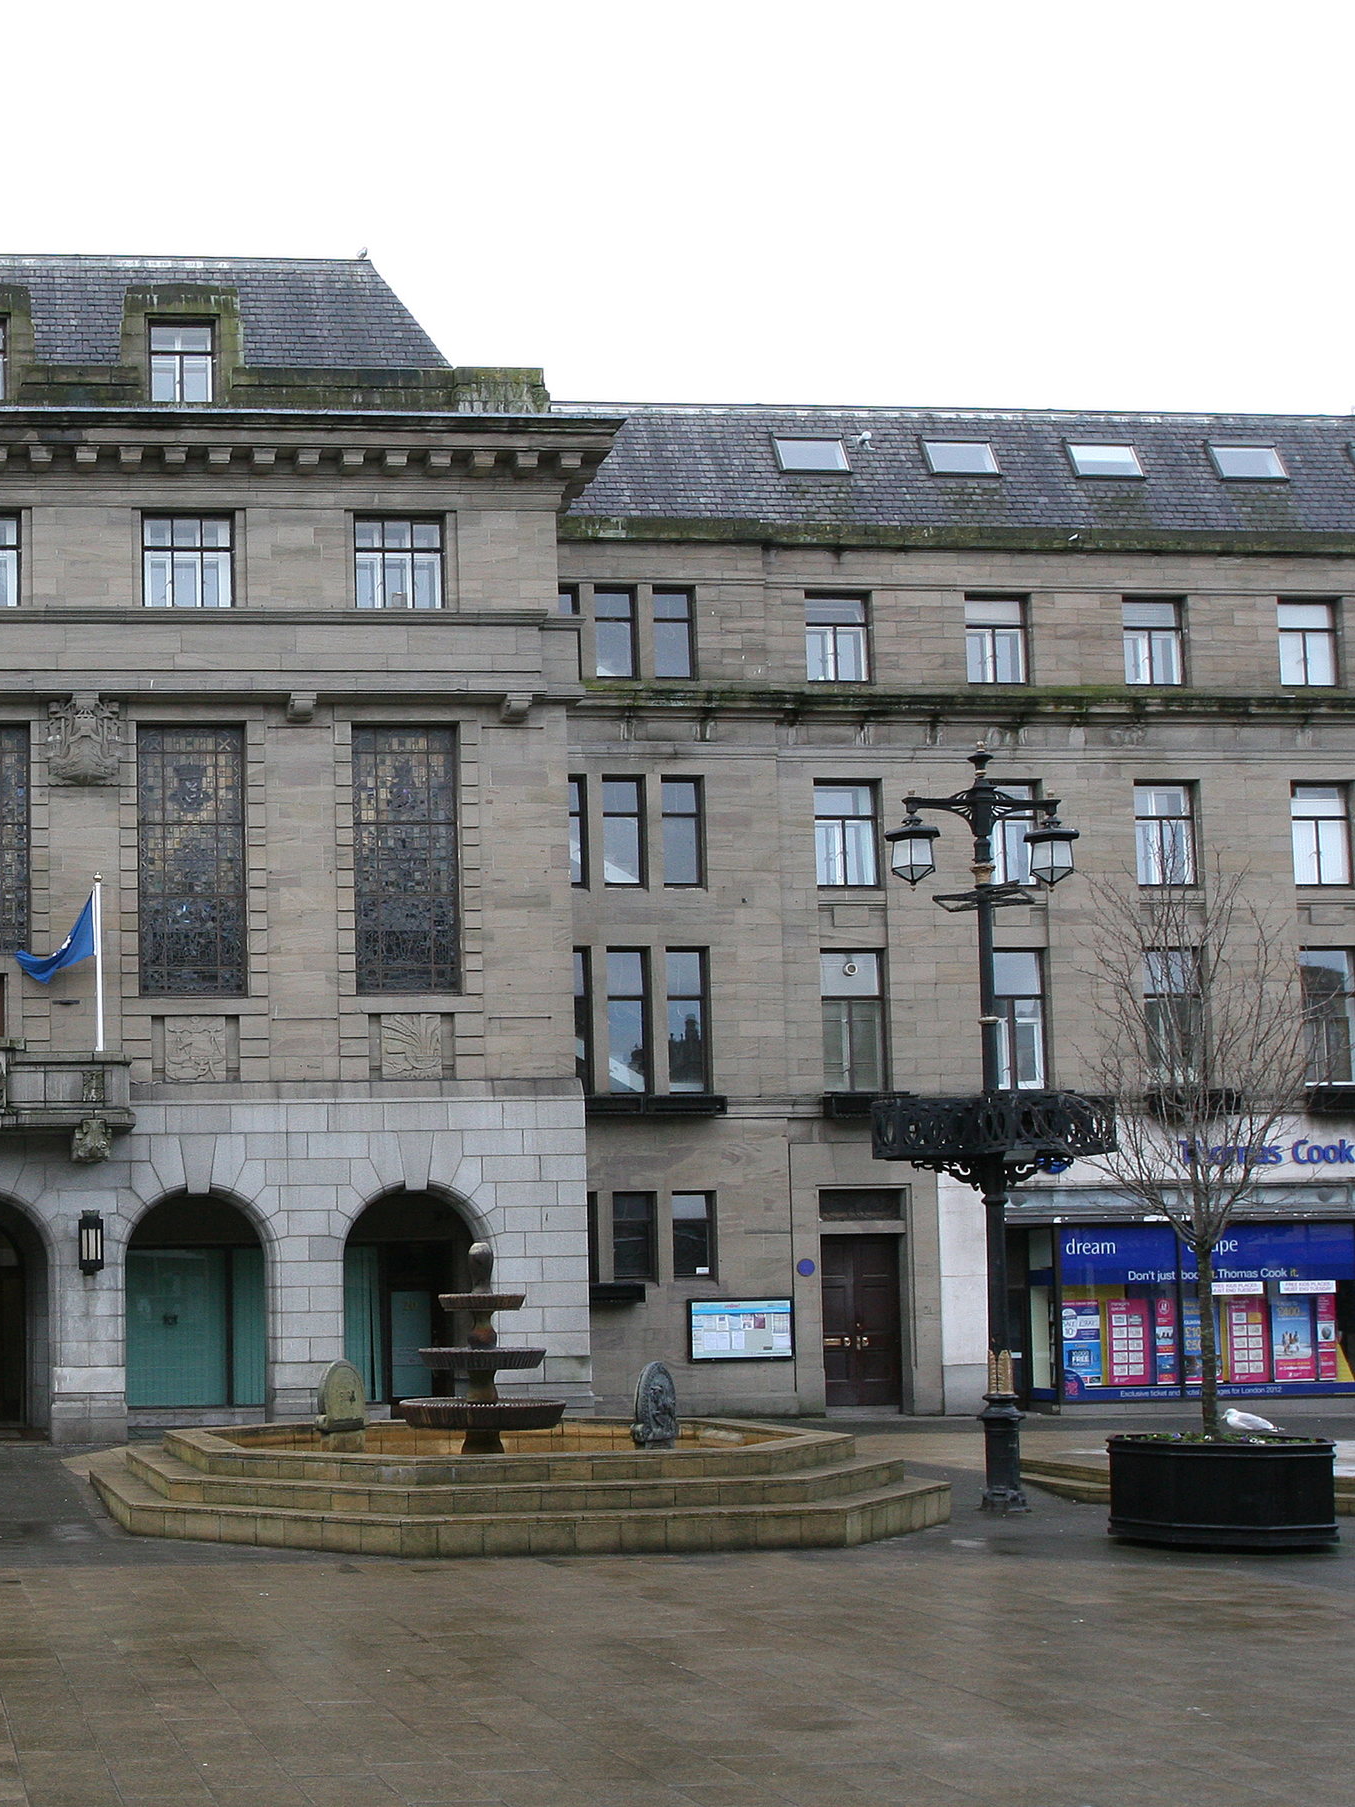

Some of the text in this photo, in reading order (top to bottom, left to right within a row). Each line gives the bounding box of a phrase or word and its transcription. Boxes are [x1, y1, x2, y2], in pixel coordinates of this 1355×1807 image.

[1292, 1139, 1355, 1165] Cook
[1065, 1238, 1239, 1255] dream eape
[1128, 1270, 1155, 1281] Don't
[1157, 1270, 1176, 1282] just
[1181, 1270, 1199, 1280] boo
[1218, 1268, 1258, 1279] Thomas
[1260, 1267, 1288, 1278] Cook
[1290, 1267, 1299, 1278] it.
[1120, 1391, 1149, 1399] Exclusive
[1150, 1389, 1168, 1397] ticket
[1241, 1387, 1264, 1395] London
[1266, 1386, 1282, 1394] 2012
